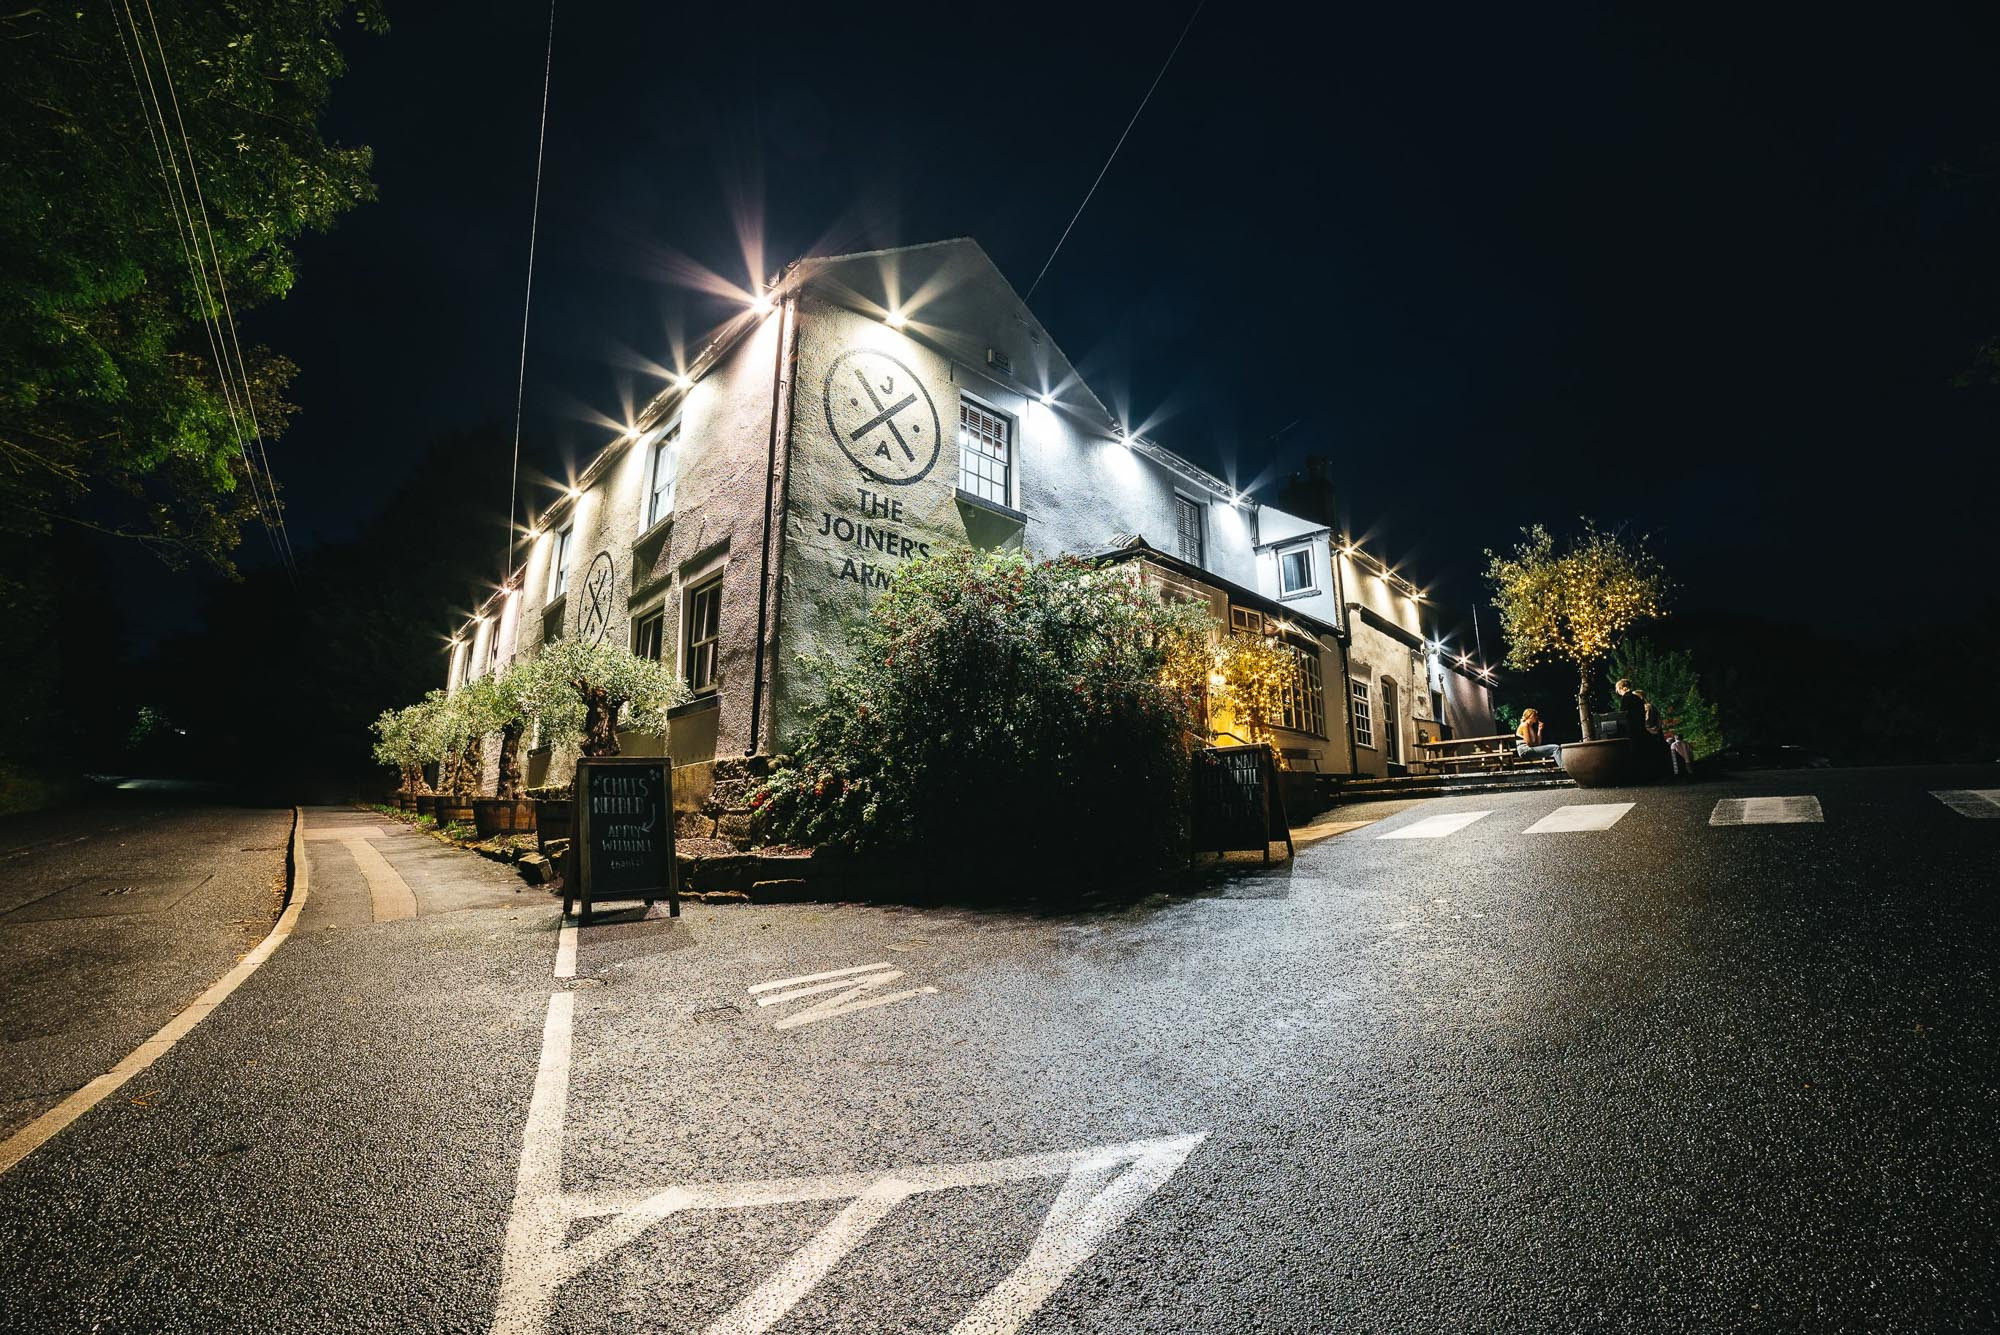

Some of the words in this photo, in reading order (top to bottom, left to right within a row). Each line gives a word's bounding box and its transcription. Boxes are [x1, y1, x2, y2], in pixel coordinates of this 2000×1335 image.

[879, 375, 895, 395] J
[875, 440, 893, 462] A
[856, 487, 903, 523] THE
[818, 512, 930, 560] JOINER'S
